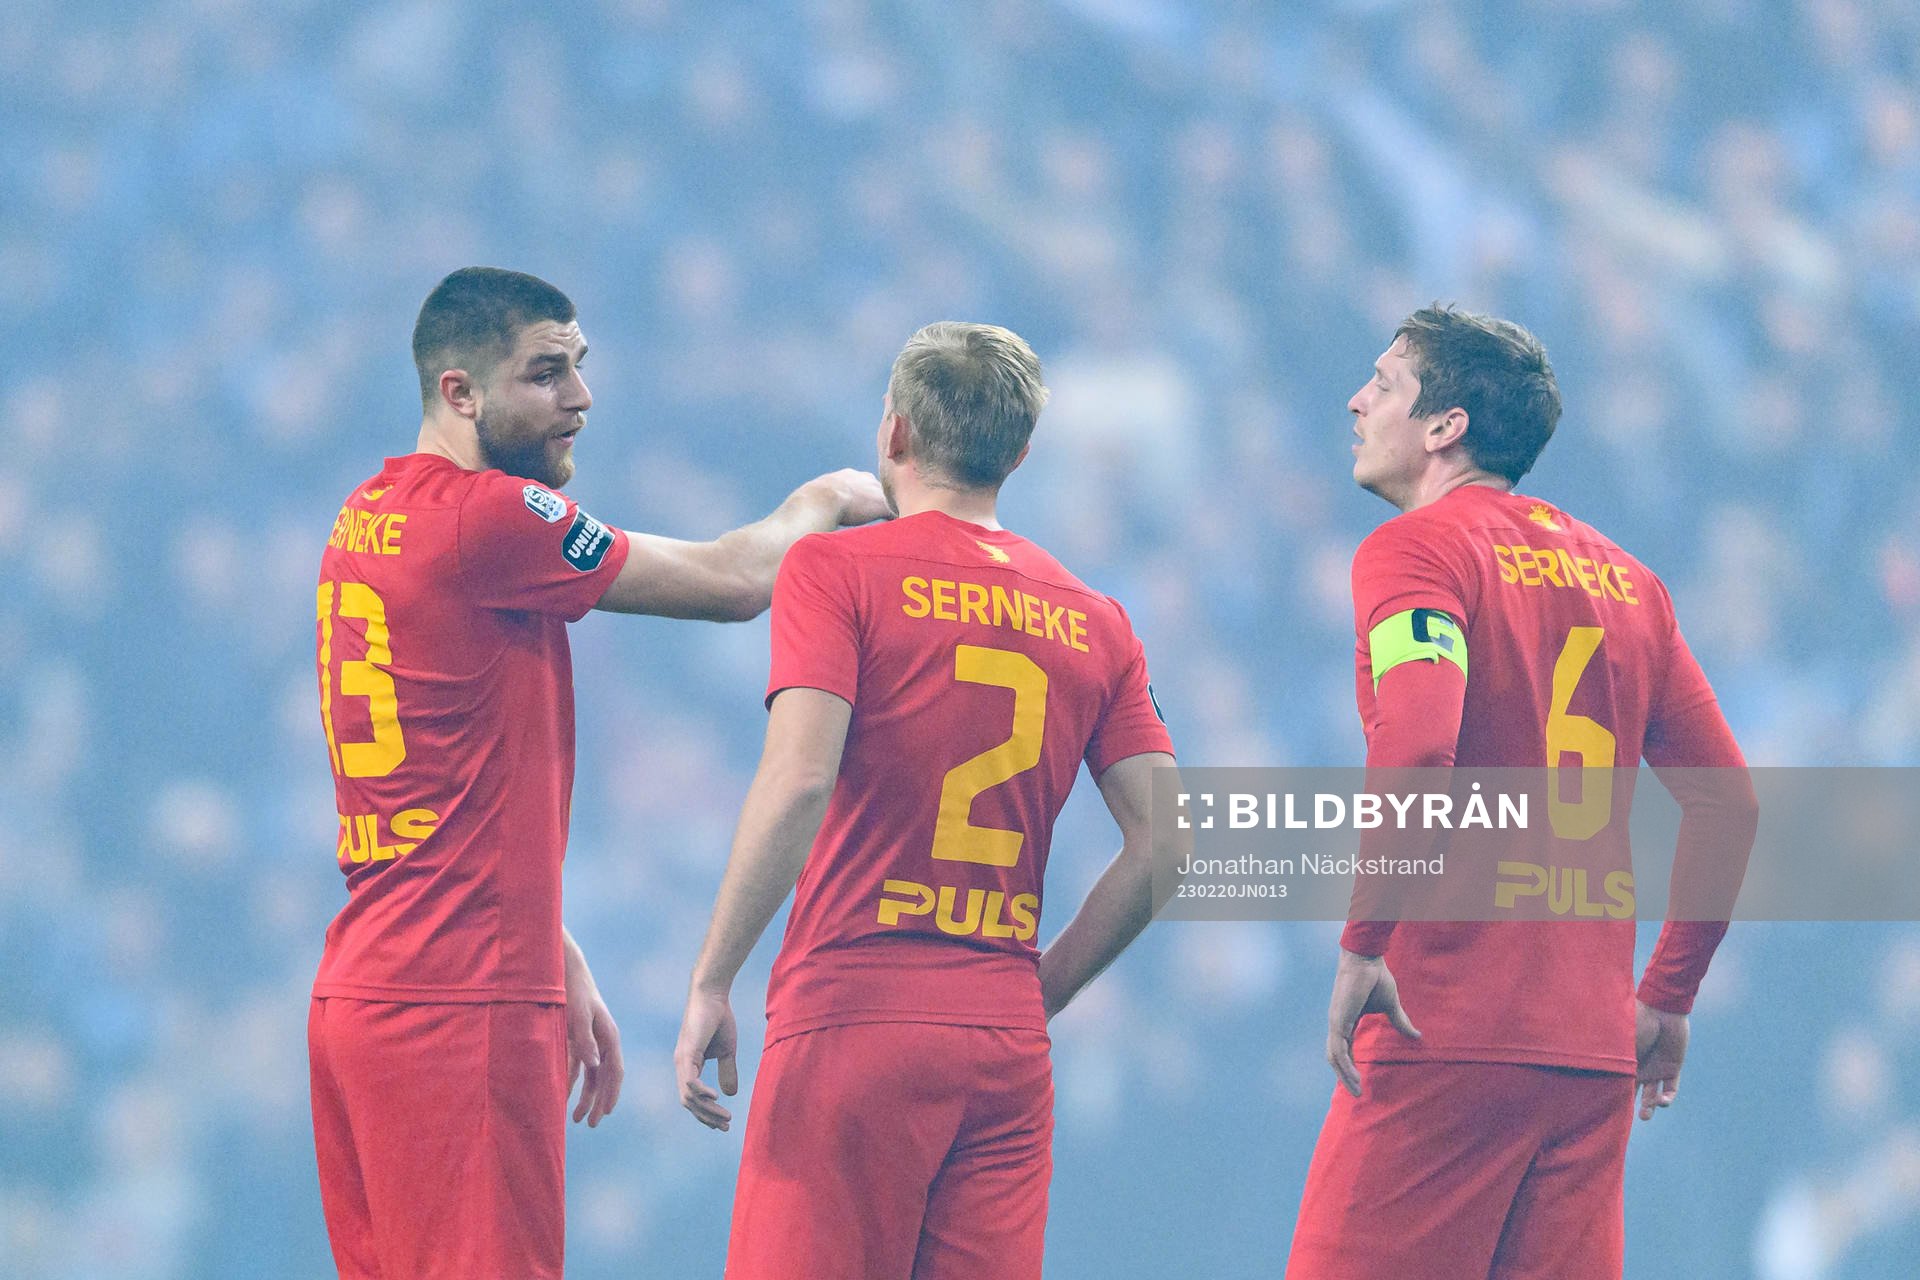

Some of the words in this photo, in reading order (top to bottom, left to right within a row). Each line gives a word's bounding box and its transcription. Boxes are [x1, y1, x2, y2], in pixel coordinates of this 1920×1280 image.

[328, 506, 407, 555] ERNEKE
[1495, 545, 1638, 605] SERNEKE
[902, 577, 1088, 652] SERNEKE
[317, 581, 406, 778] 13
[932, 645, 1048, 866] 2
[1546, 627, 1616, 840] 6
[878, 880, 1038, 941] PULS
[1495, 861, 1635, 918] PULS
